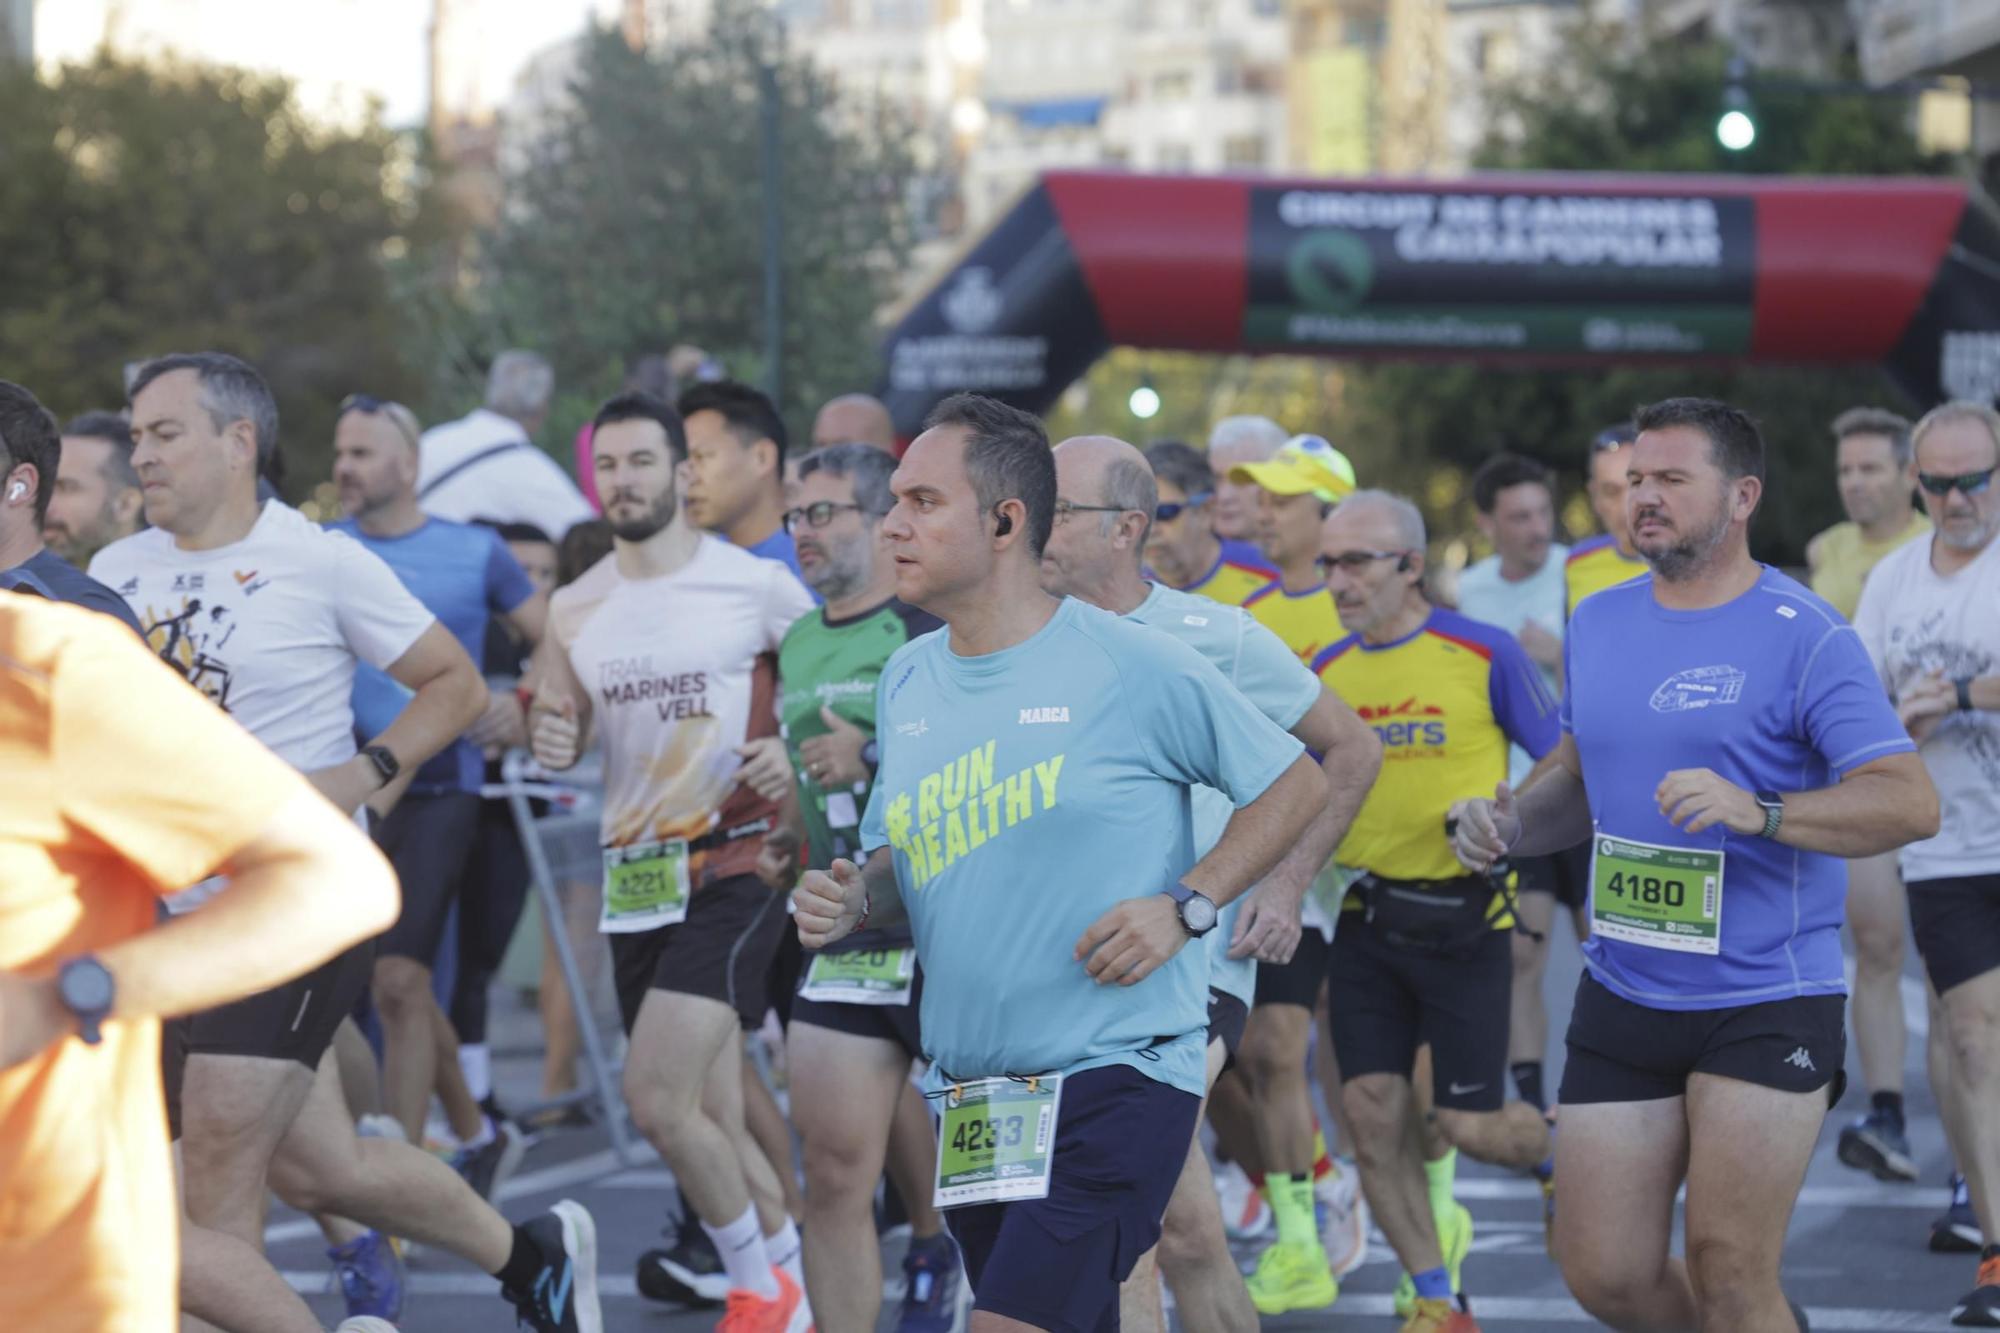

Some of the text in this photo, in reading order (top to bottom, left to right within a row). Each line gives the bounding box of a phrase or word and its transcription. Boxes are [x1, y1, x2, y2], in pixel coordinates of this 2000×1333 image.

[602, 671, 707, 706] MARINES
[657, 696, 714, 721] VELL
[1019, 706, 1069, 724] MARCA
[903, 754, 1065, 891] HEALTHY
[1607, 871, 1685, 907] 4180
[952, 1115, 1025, 1153] 4233
